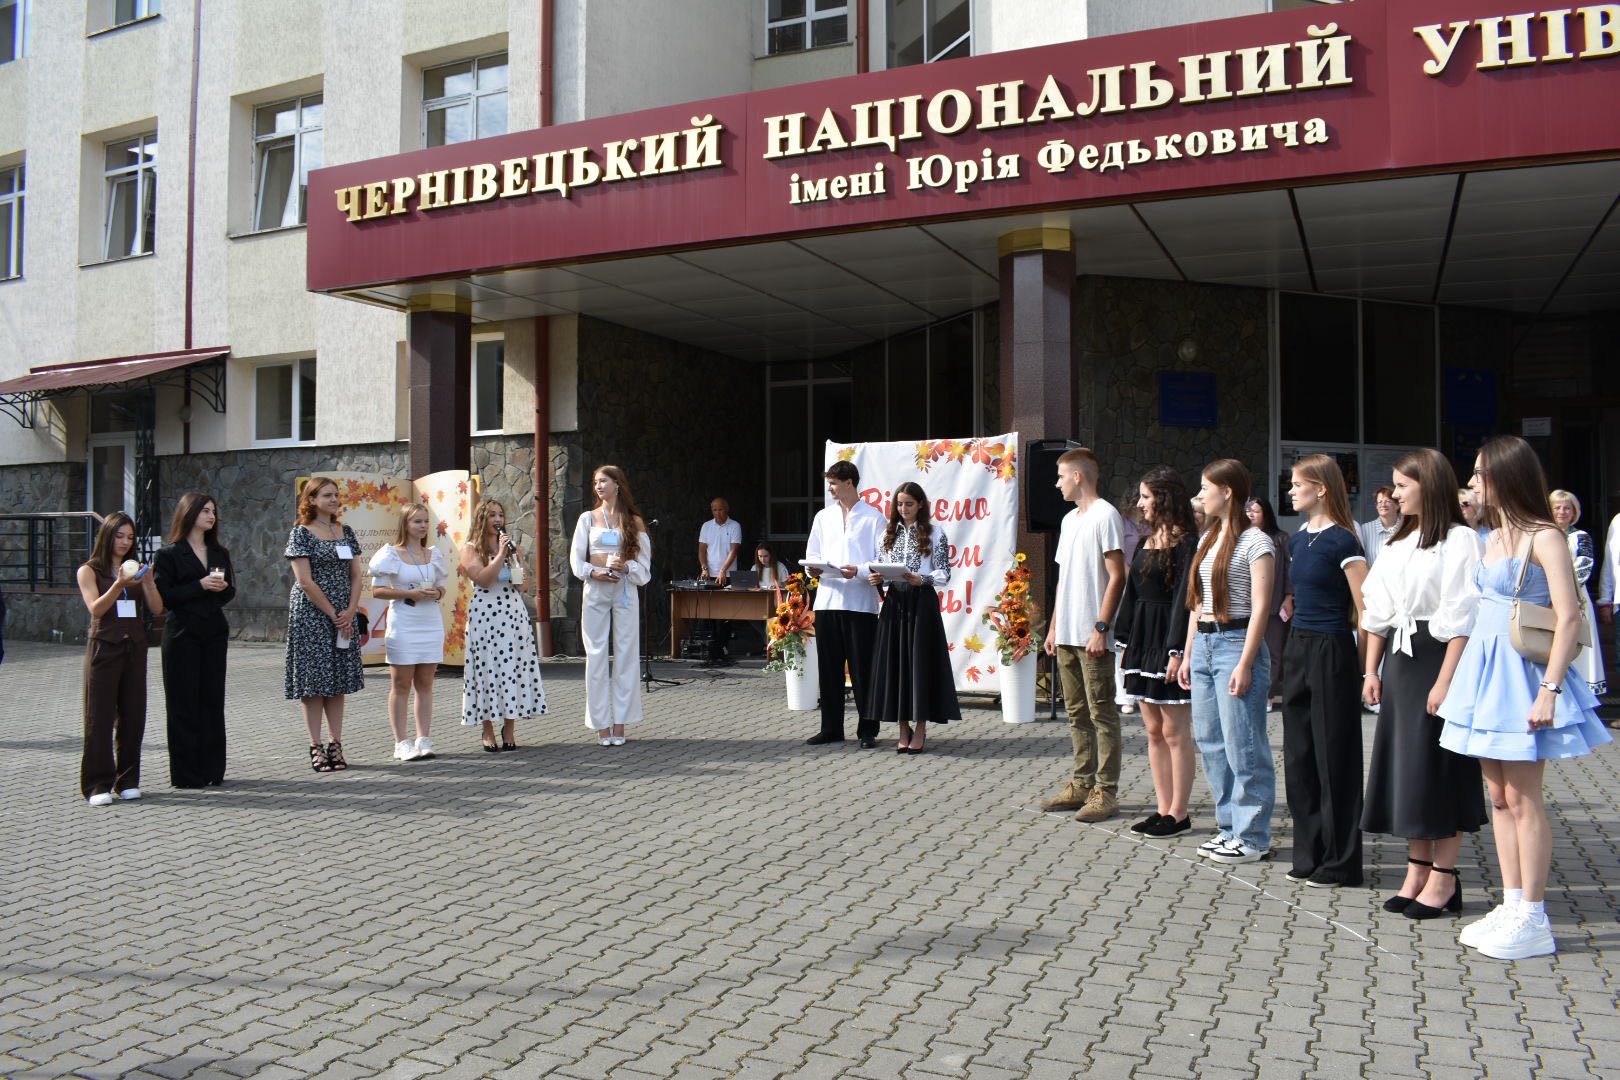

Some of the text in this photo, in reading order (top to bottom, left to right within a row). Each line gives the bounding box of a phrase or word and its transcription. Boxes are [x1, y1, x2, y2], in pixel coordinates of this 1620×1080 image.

[335, 4, 1620, 223] ЧЕРНІВЕЦЬКИЙ НАЦІОНАЛЬНИЙ УНІВ
[789, 117, 1329, 204] імені Юрія Федьковича
[859, 487, 991, 523] Віємо
